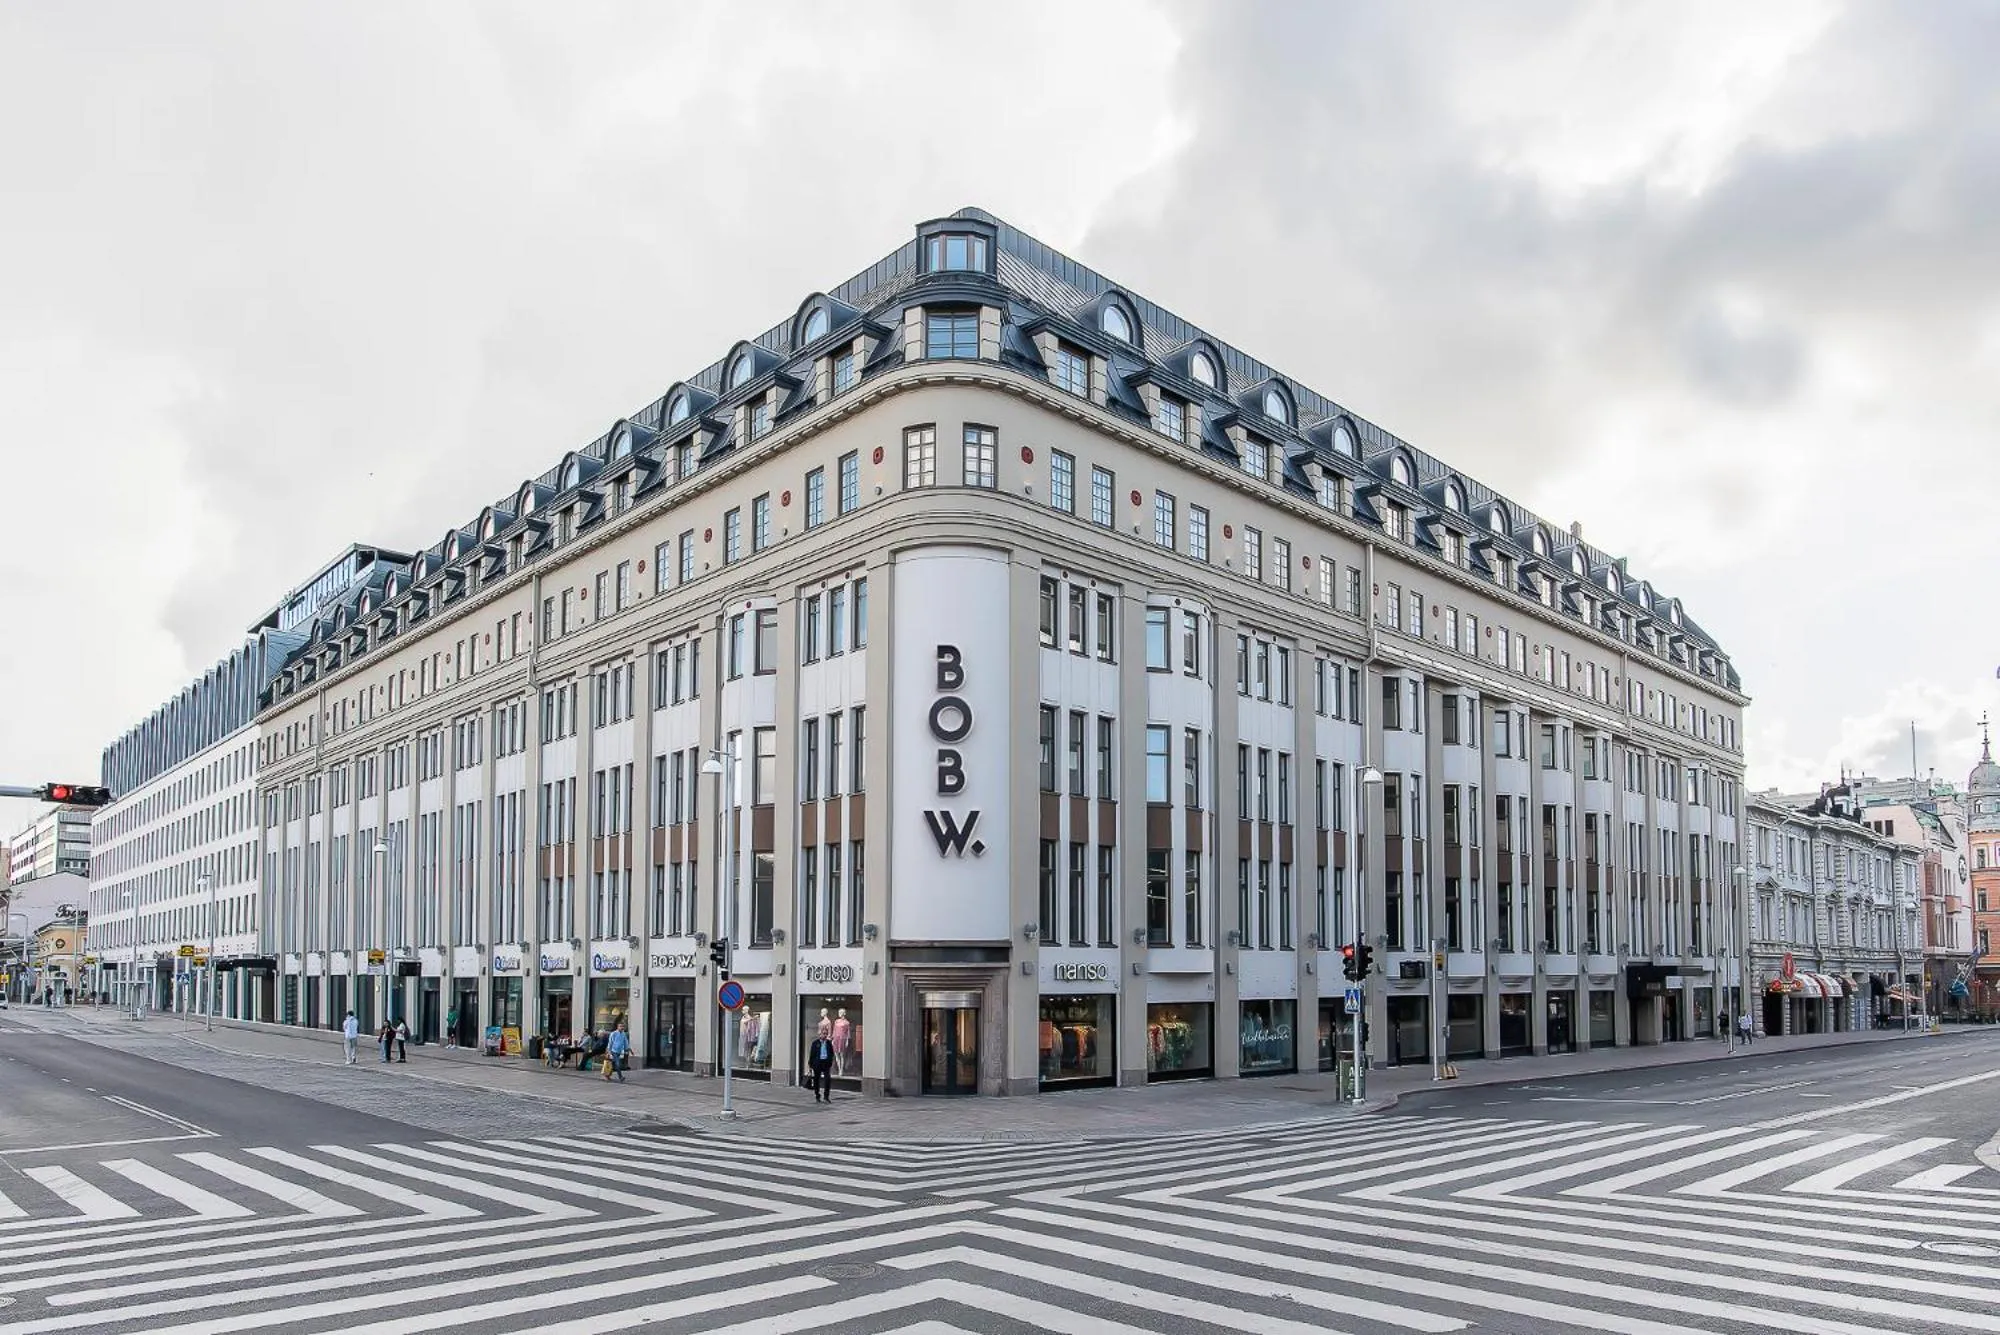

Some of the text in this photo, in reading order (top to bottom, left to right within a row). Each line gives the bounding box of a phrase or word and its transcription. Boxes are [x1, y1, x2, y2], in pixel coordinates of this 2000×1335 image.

[923, 644, 986, 858] BOB W.
[651, 954, 677, 968] BOB
[1054, 962, 1107, 981] nanso
